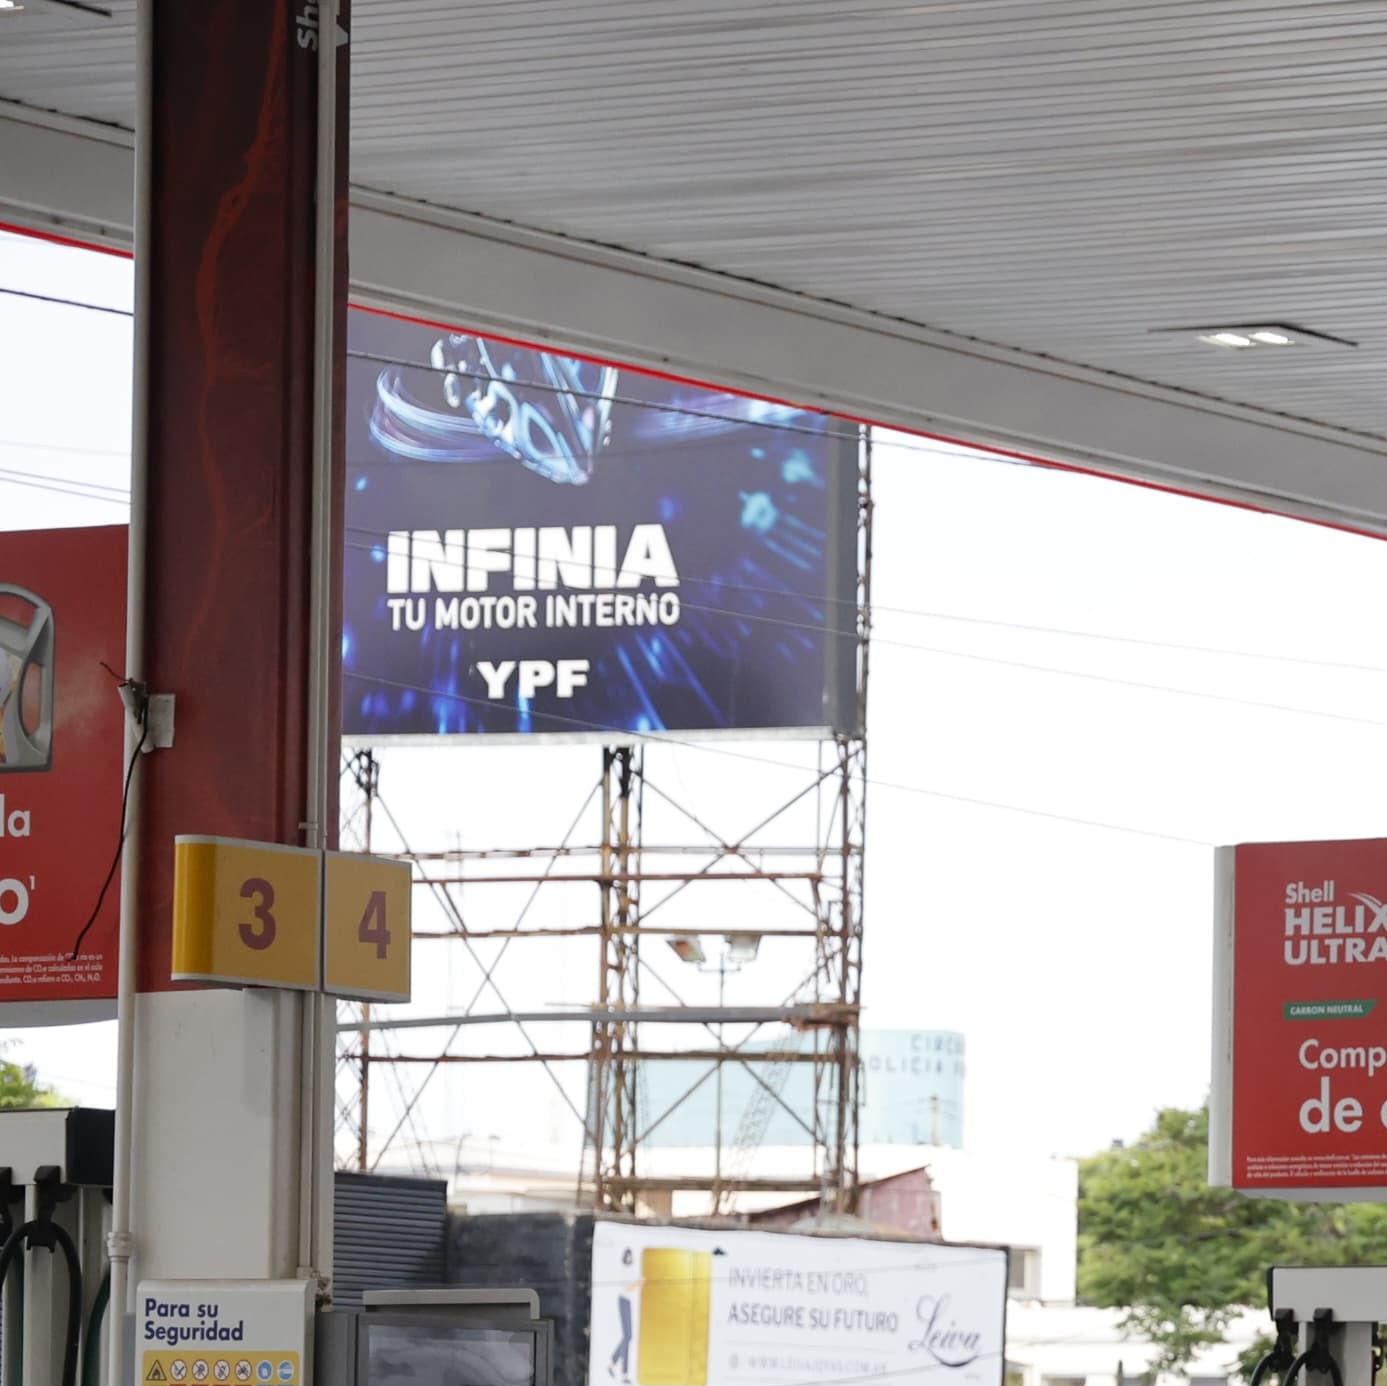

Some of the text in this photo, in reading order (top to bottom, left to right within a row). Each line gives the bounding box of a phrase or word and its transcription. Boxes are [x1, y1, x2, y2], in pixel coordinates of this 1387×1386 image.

[385, 524, 680, 595] INFINIA
[388, 593, 680, 631] TU MOTOR INTERNO
[476, 660, 590, 700] YPF
[1285, 880, 1334, 904] Shell
[239, 878, 277, 951] 3
[358, 890, 391, 959] 4
[1290, 1003, 1363, 1016] CARBON NEUTRAL
[1300, 1076, 1363, 1134] de
[729, 1267, 803, 1292] INVIERTA
[807, 1273, 829, 1294] EN
[145, 1297, 218, 1318] Para su
[728, 1303, 898, 1333] ASEGURE SU FUTURO
[144, 1320, 244, 1346] Seguridad
